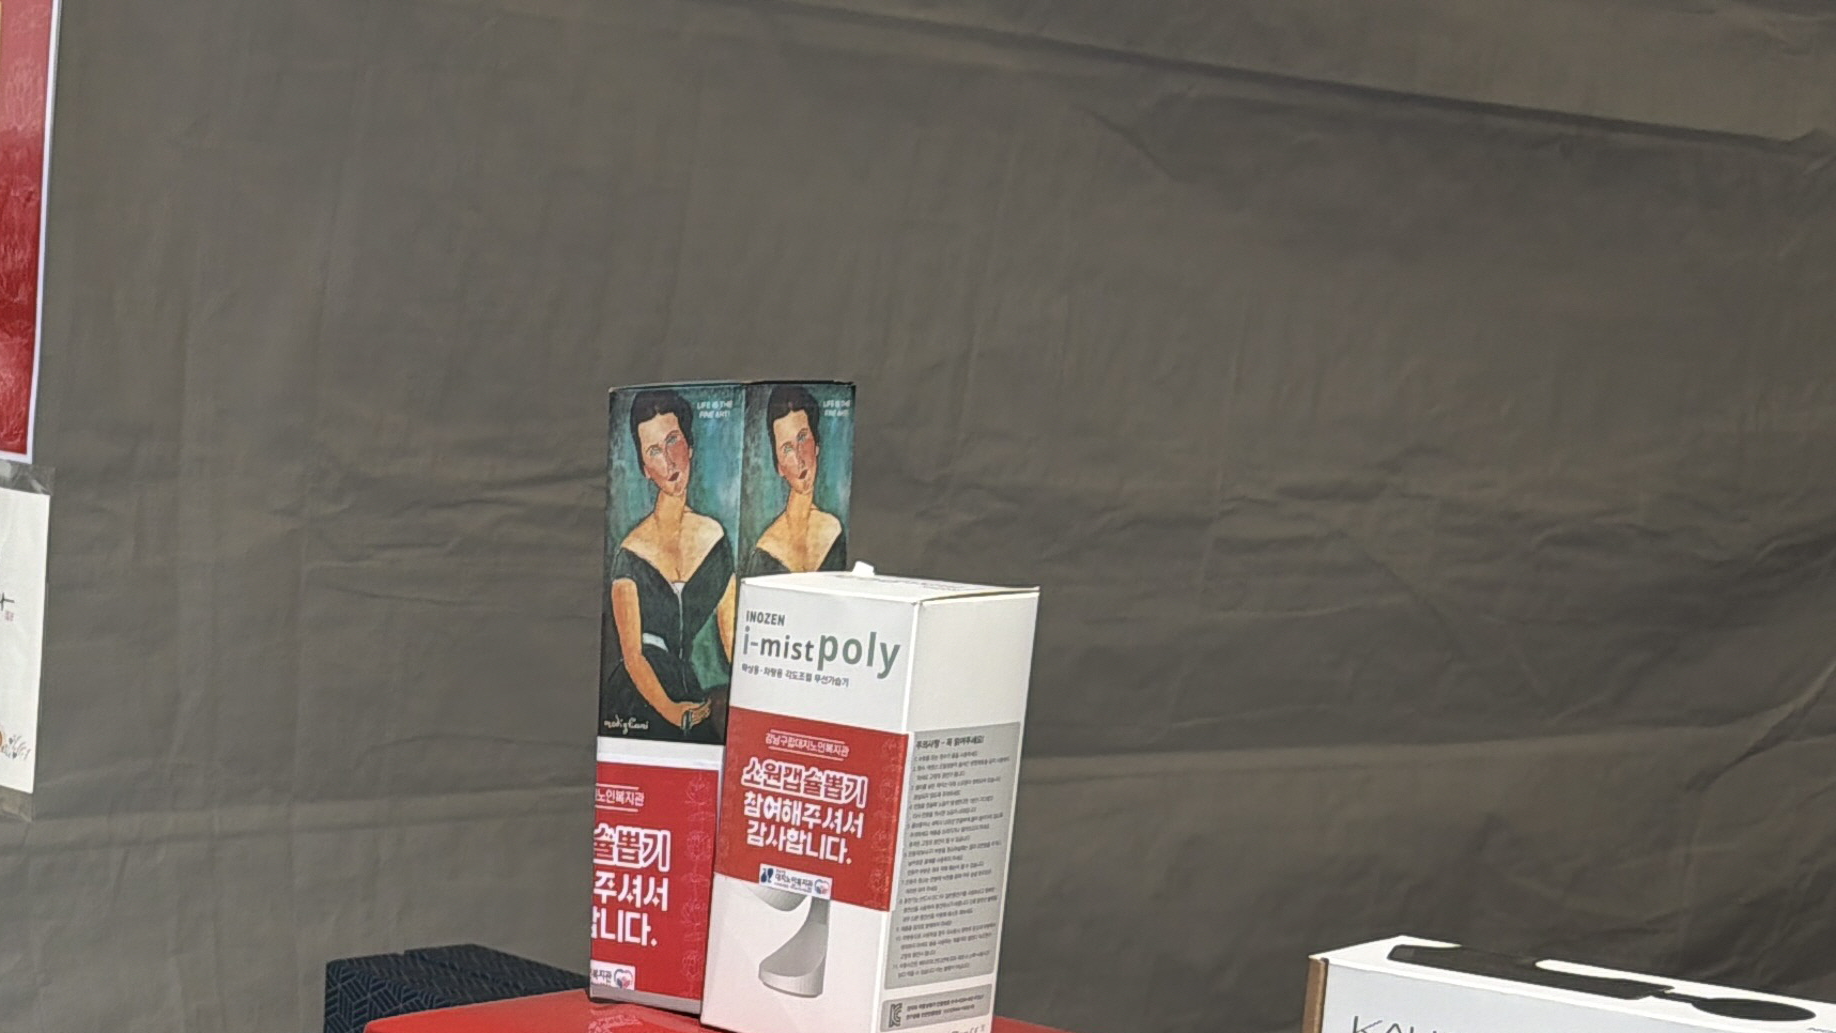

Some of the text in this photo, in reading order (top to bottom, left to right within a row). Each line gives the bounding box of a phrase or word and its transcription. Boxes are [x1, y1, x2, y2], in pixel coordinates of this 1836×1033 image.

[746, 611, 785, 626] INOZEN
[743, 626, 901, 679] i-mist poly
[741, 757, 868, 808] 소원캡슐뽑기
[744, 791, 864, 838] 참여해주셔서
[747, 820, 852, 864] 감사합니다.
